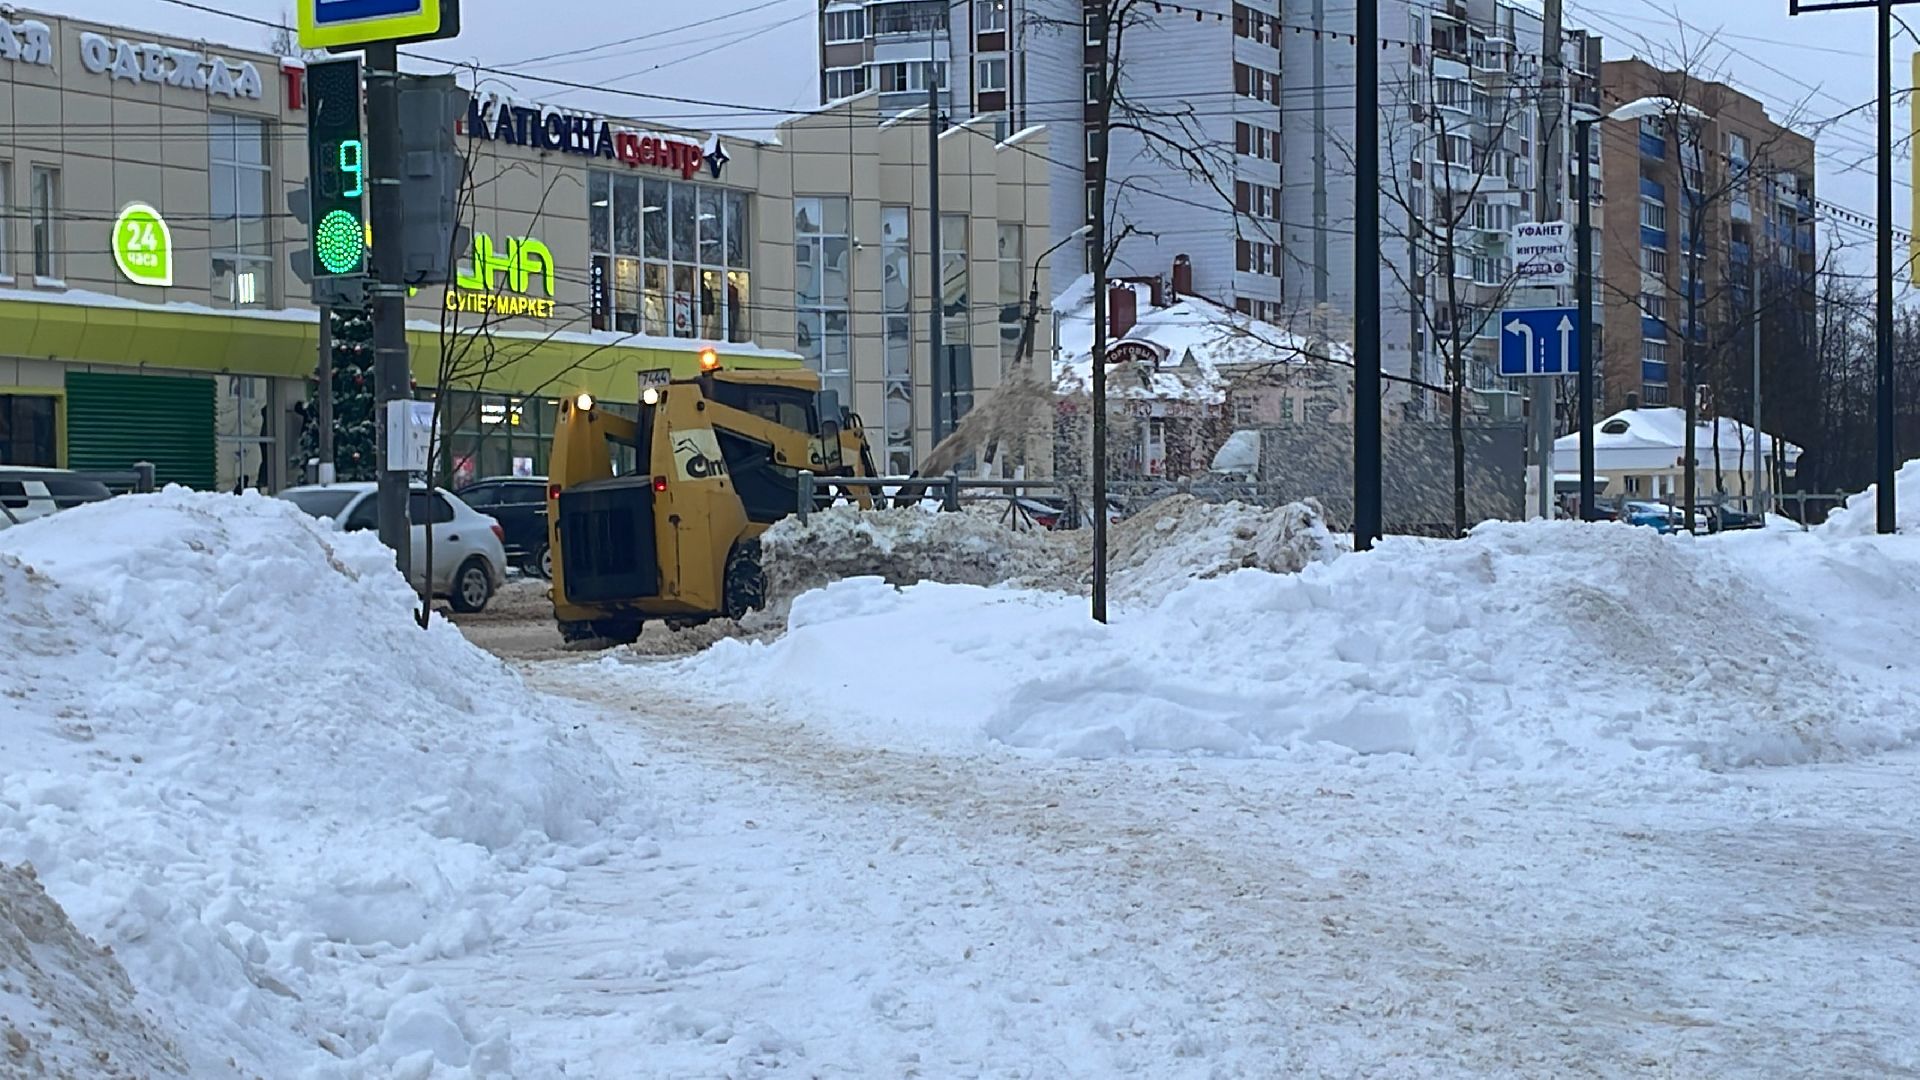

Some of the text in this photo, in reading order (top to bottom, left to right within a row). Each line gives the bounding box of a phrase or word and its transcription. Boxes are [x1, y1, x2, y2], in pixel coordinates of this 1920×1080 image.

[80, 31, 262, 99] ОДЕЖДА
[468, 95, 615, 160] КАТЮША
[340, 140, 363, 197] 9
[127, 220, 158, 251] 24
[1518, 225, 1563, 237] УФАНЕТ
[1516, 245, 1563, 255] ИНТЕРНЕТ
[446, 290, 556, 318] СУПЕРМАРКЕТ
